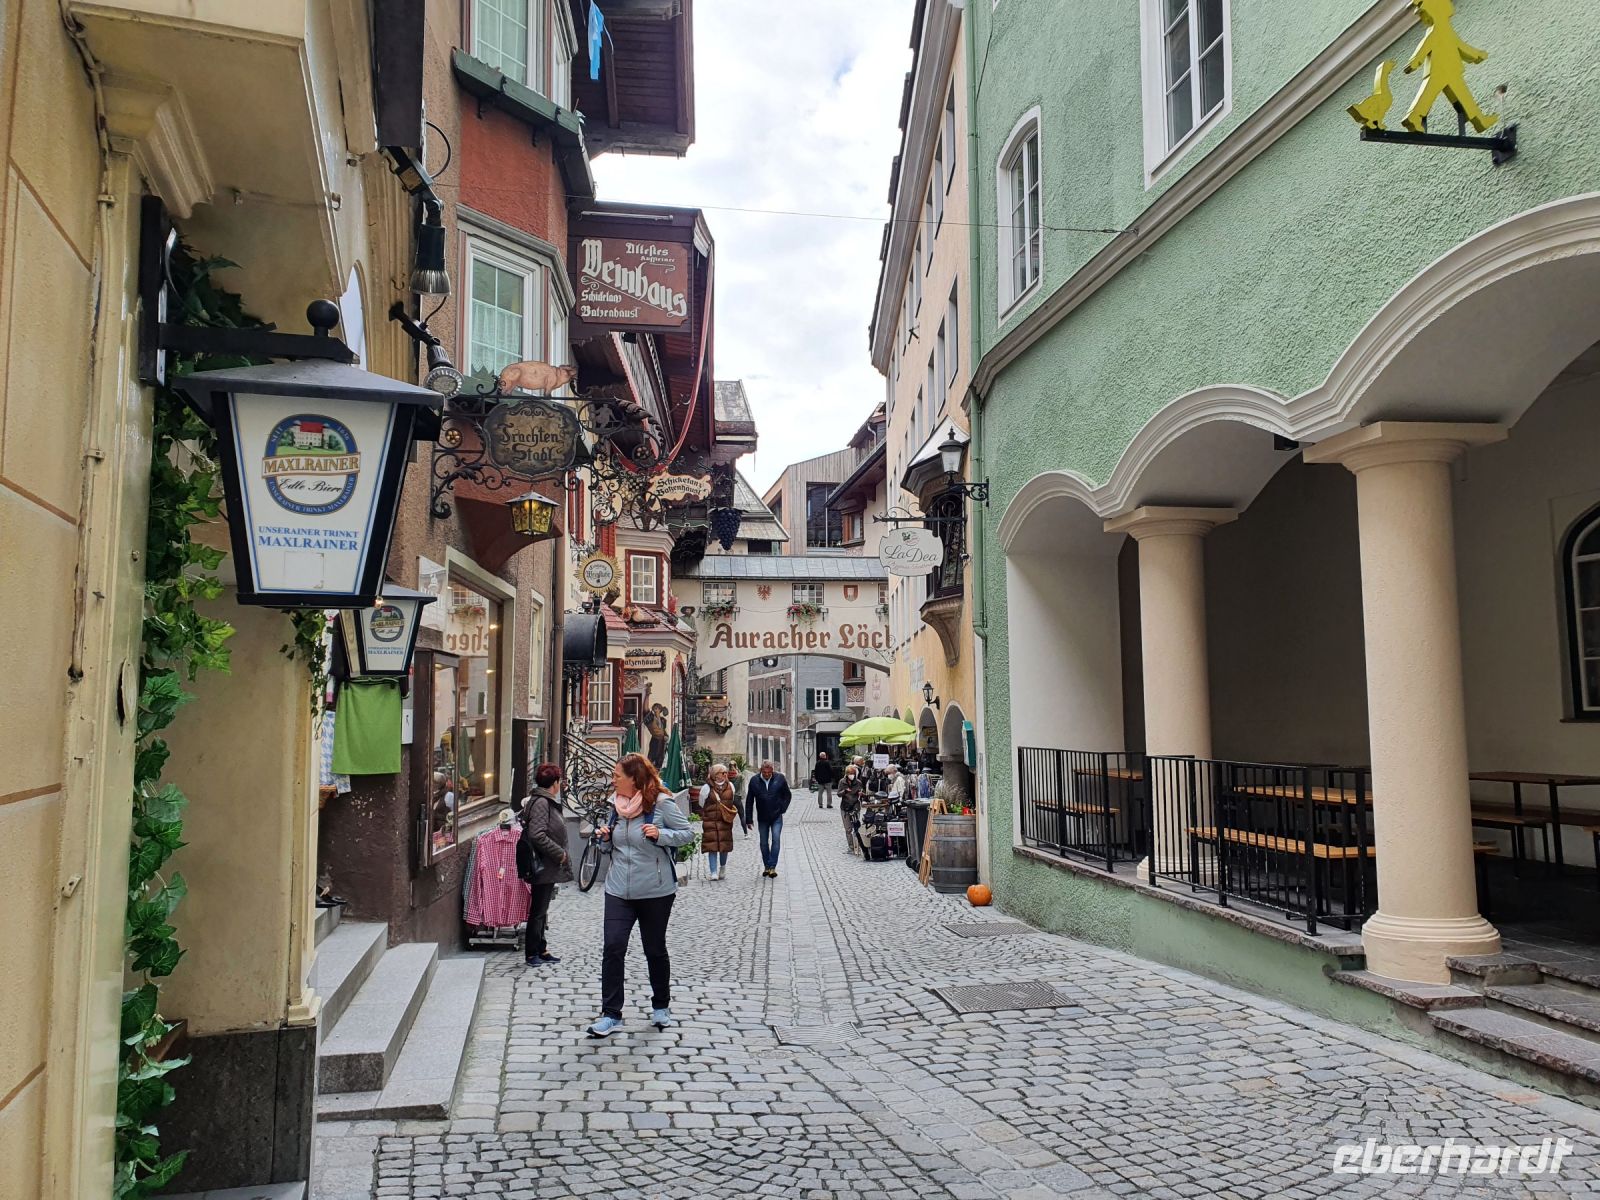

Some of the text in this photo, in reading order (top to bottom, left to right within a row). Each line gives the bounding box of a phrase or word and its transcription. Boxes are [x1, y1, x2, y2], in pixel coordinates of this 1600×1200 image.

[581, 238, 688, 317] Weinhaus
[271, 426, 284, 442] SEIT
[498, 422, 562, 447] Trachten
[511, 443, 556, 463] Stadl
[264, 456, 359, 474] MAXLRAINER
[279, 478, 343, 493] Edle Biere
[258, 526, 359, 539] UNSERAINER TRINKT
[258, 535, 359, 551] MAXLRAINER
[884, 545, 938, 563] La Dea
[710, 622, 831, 650] Auracher
